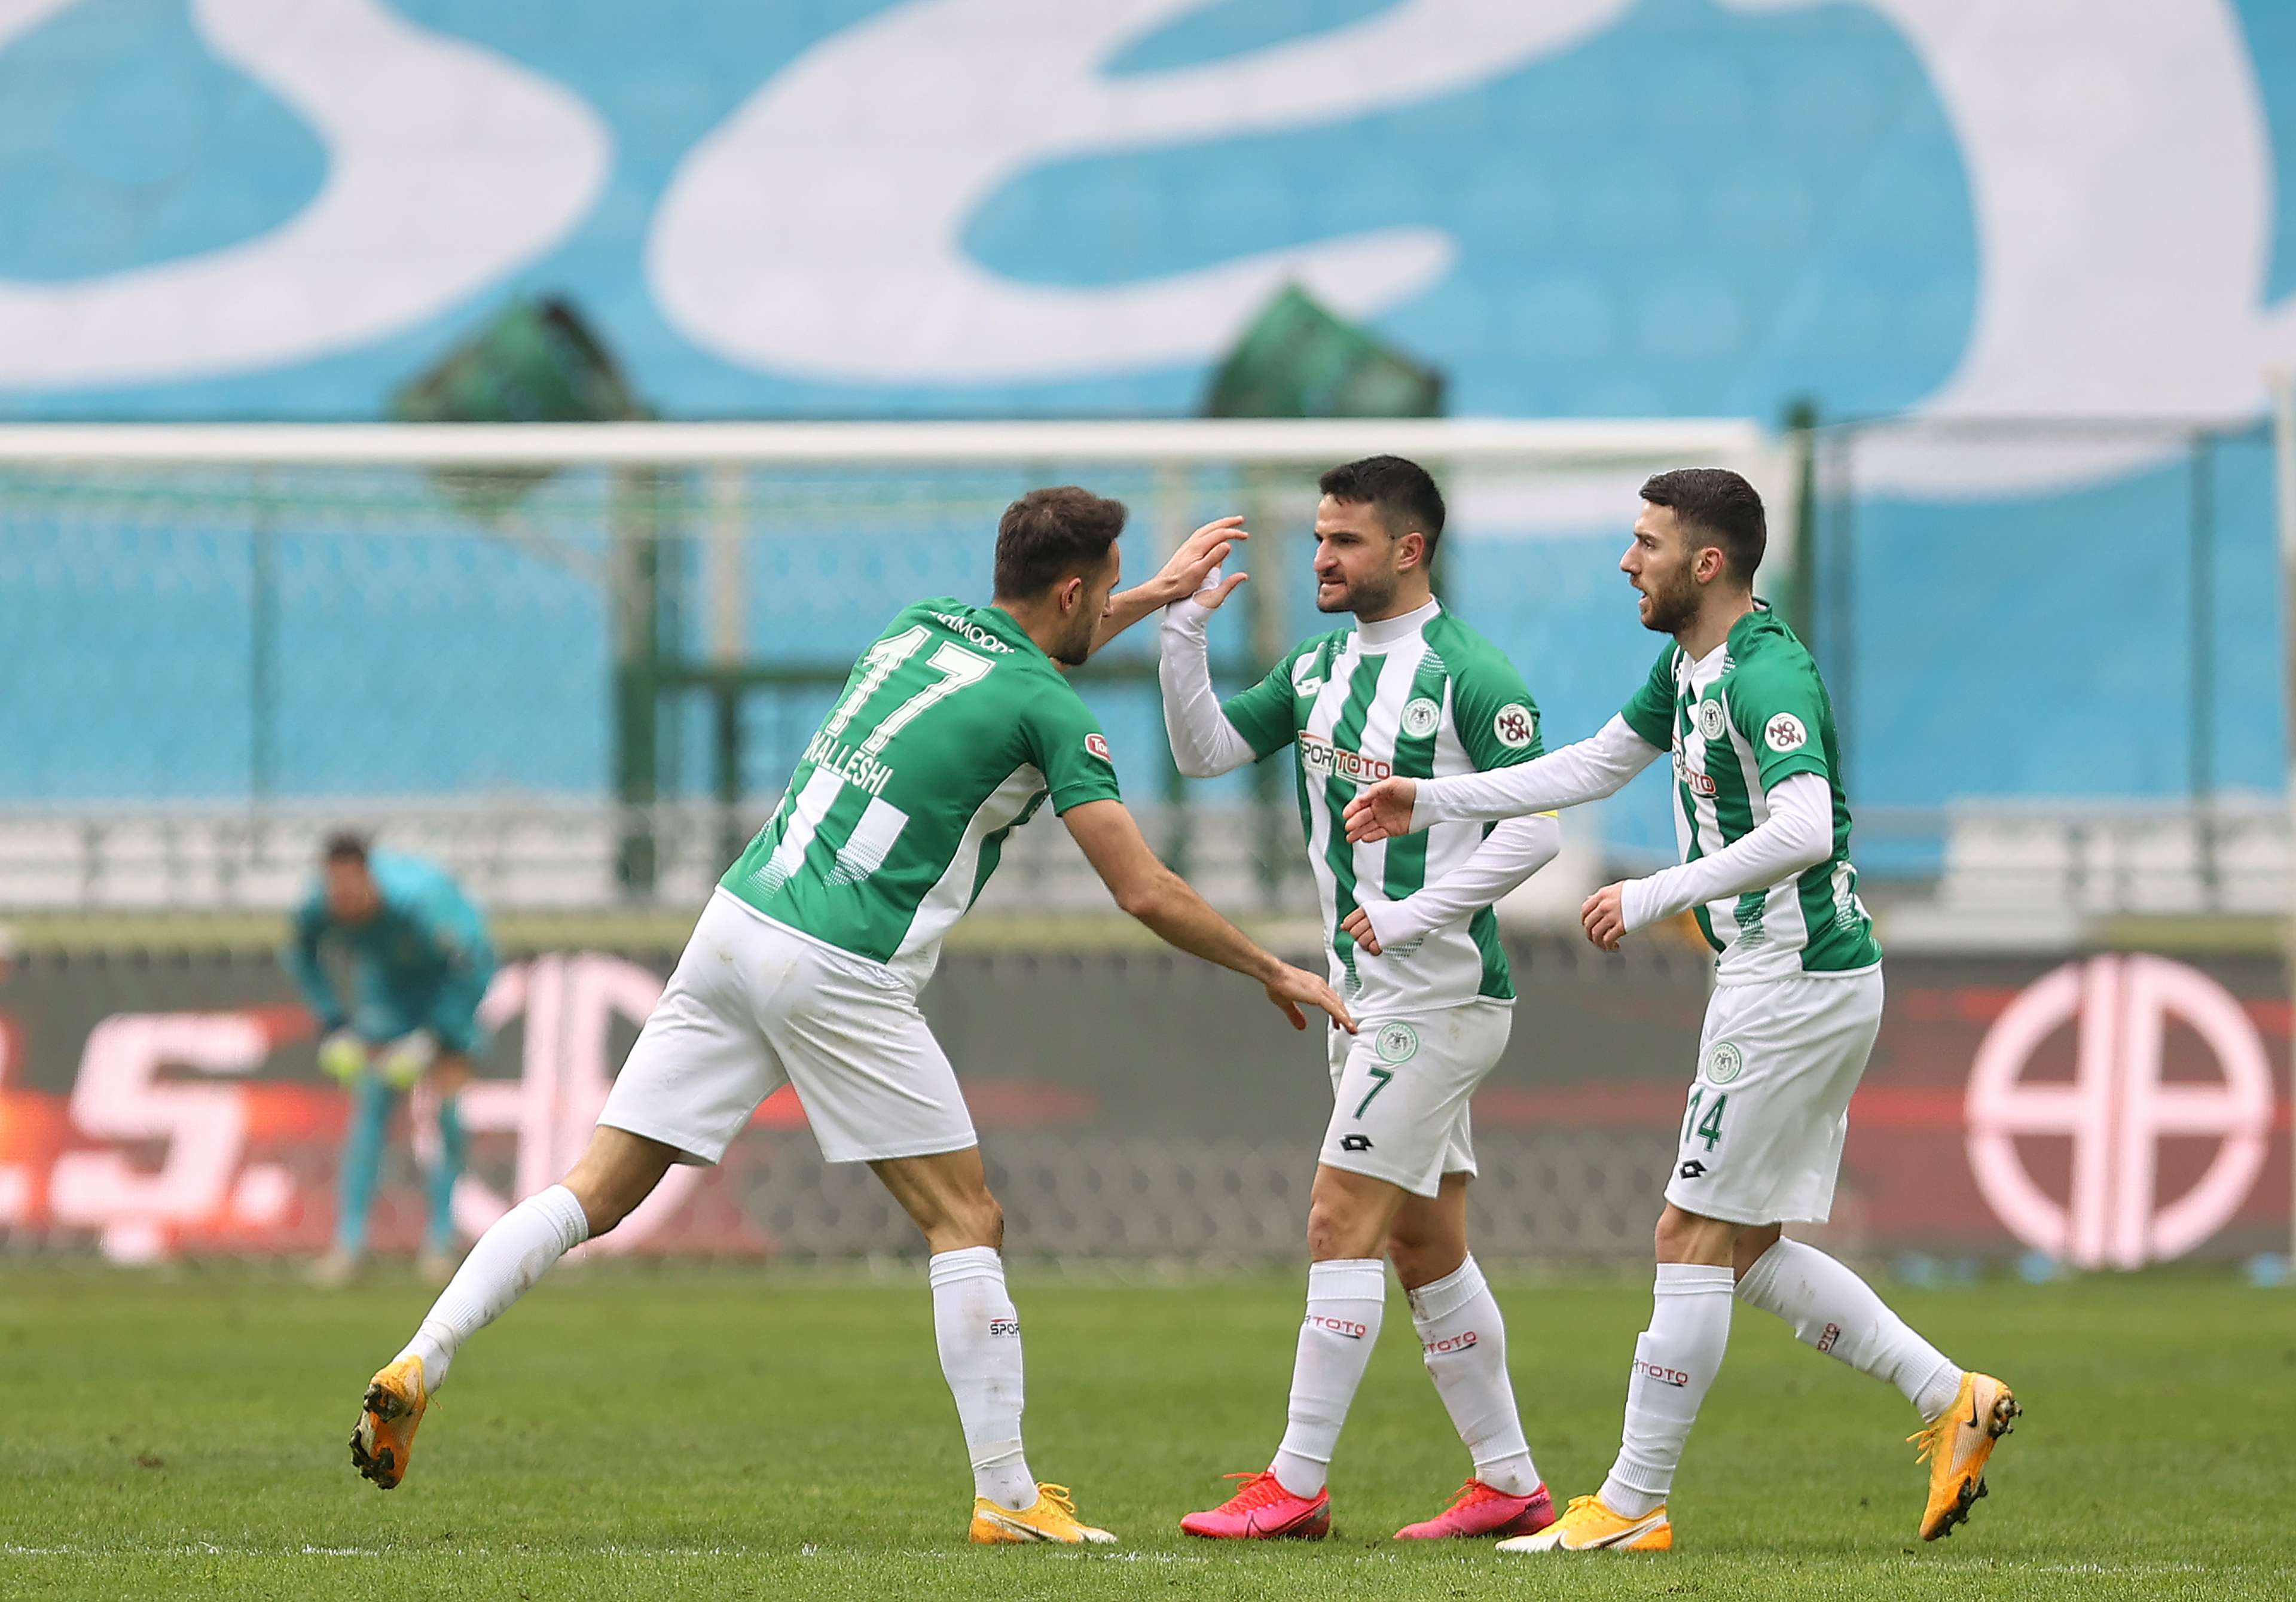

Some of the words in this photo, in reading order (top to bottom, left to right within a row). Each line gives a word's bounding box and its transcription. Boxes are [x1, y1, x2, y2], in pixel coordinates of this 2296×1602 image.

[825, 625, 996, 757] 17
[1352, 1066, 1394, 1120] 7
[1685, 1087, 1729, 1152] 14
